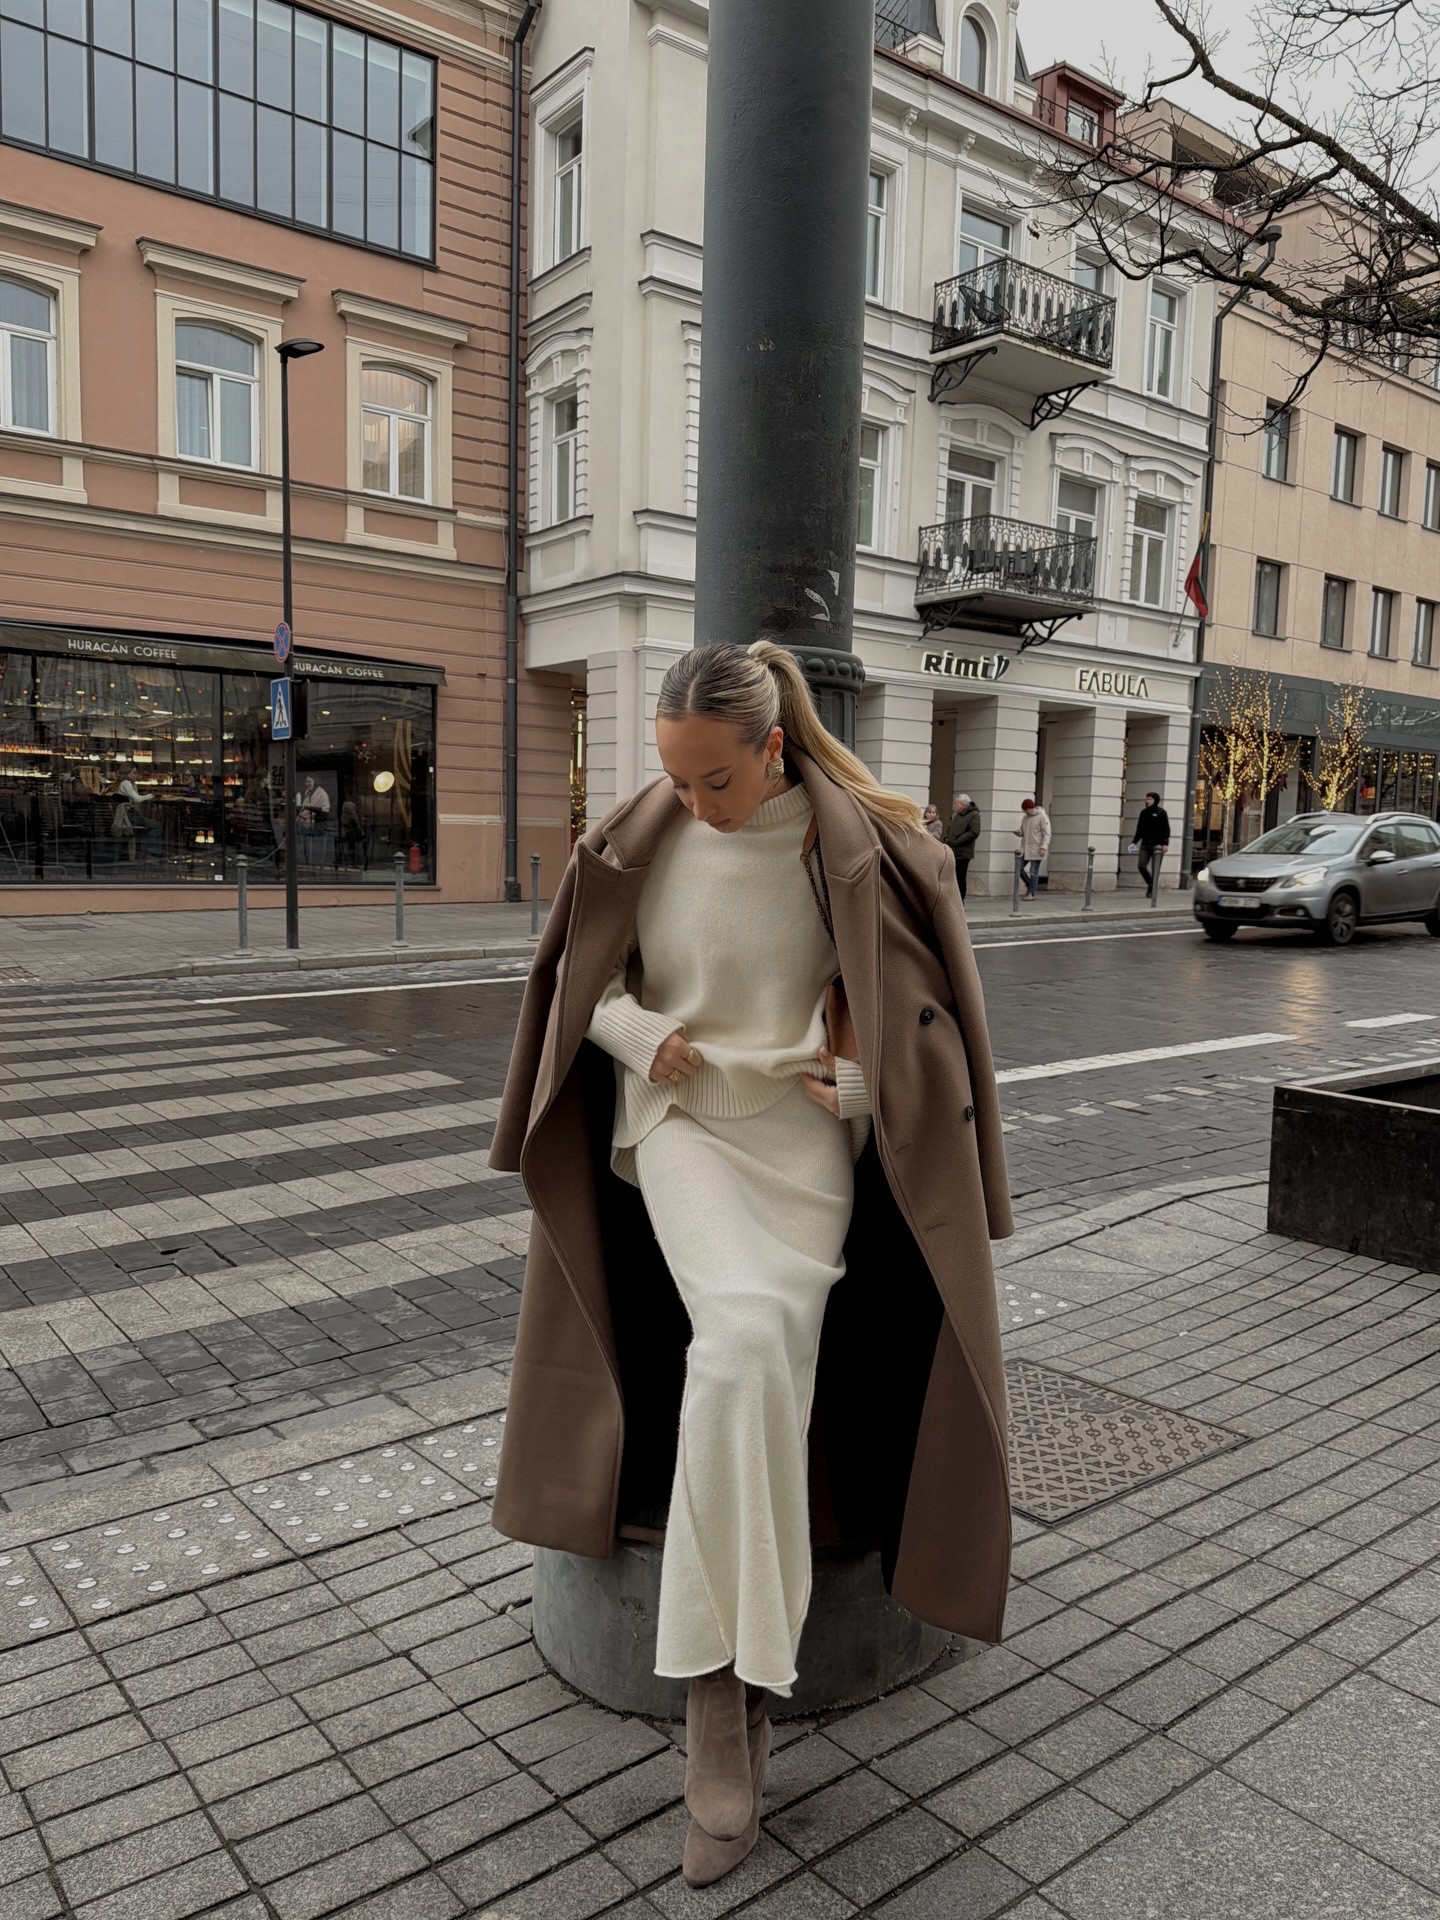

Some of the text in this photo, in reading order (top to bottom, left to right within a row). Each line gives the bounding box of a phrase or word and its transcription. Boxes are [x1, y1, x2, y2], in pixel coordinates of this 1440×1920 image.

[67, 638, 178, 660] HURACÁN COFFEE
[346, 667, 385, 678] COFFEE
[923, 651, 991, 679] Rimi
[1077, 668, 1150, 698] FABULA
